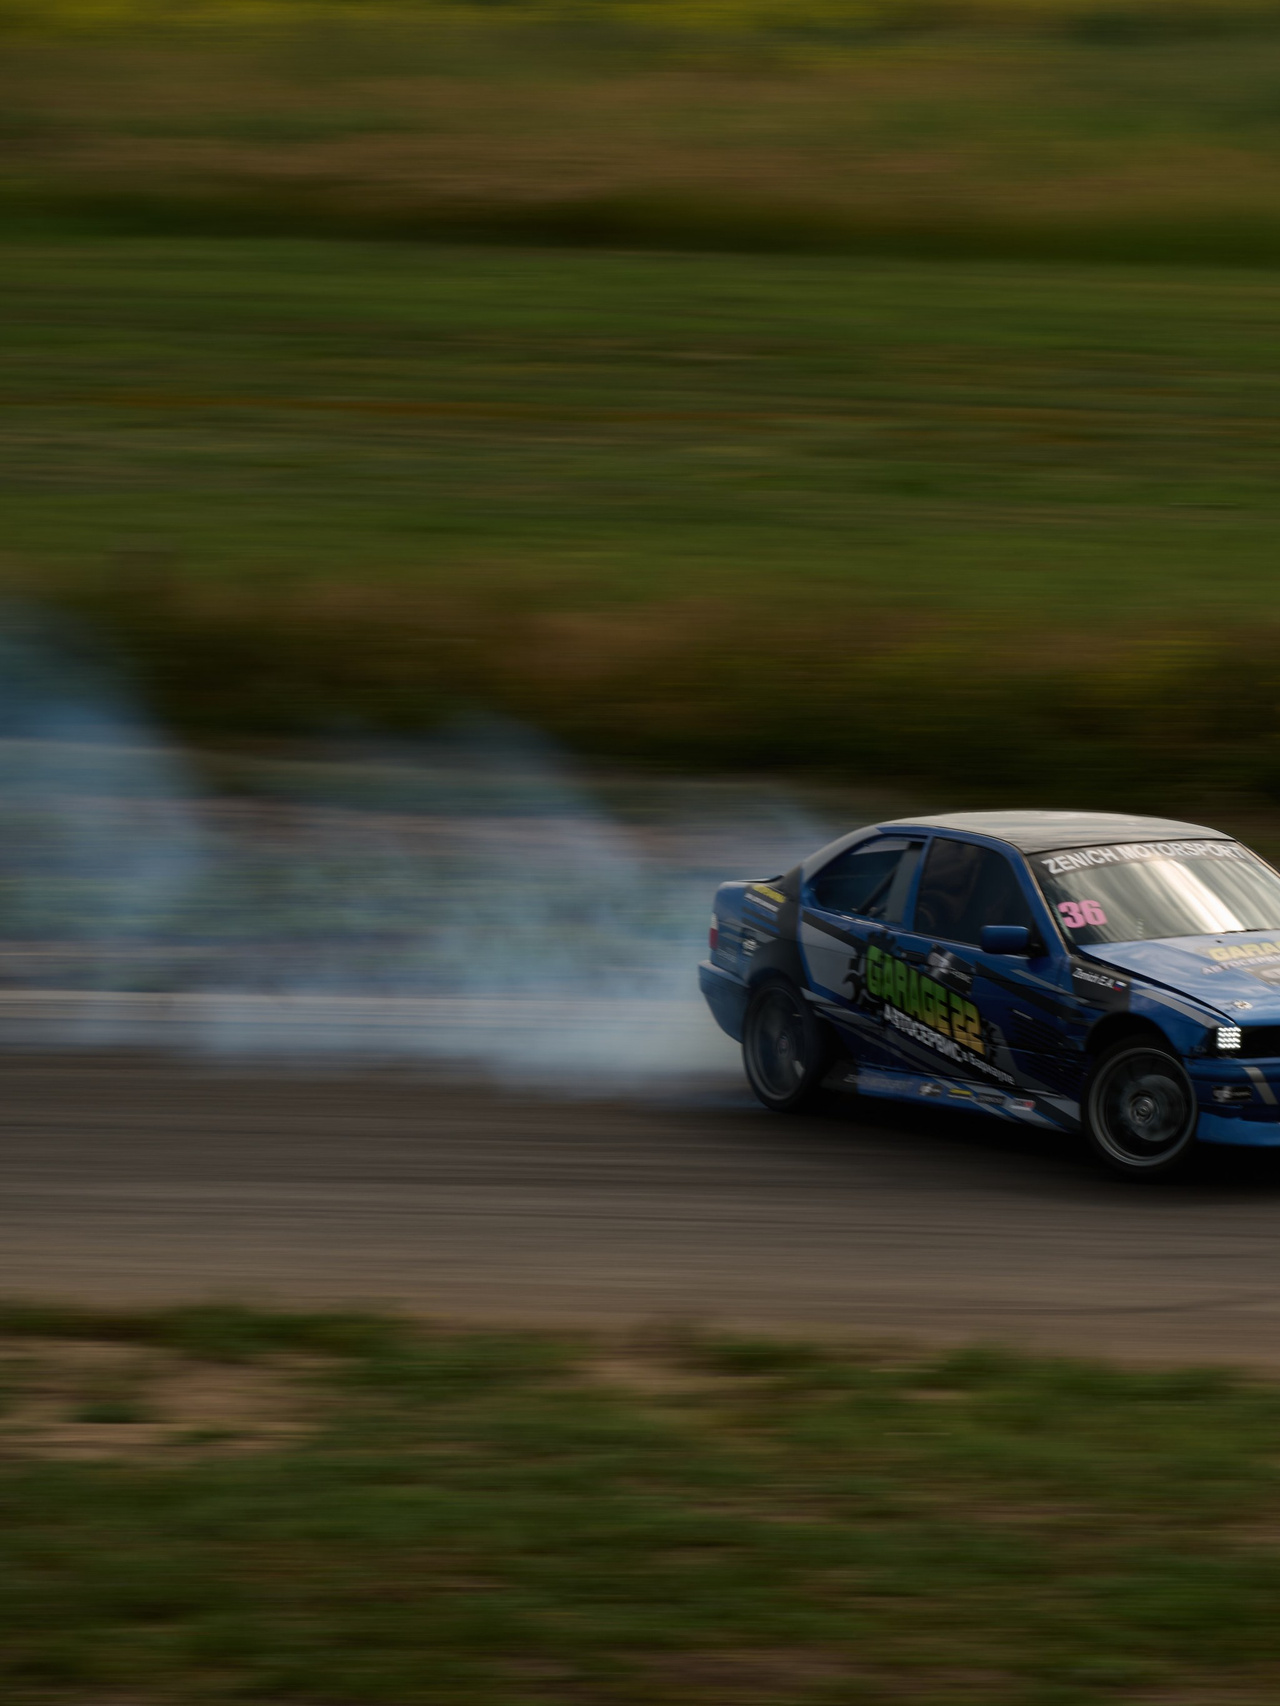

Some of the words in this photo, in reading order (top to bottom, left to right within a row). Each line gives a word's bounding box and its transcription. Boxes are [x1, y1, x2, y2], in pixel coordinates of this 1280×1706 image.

[1041, 848, 1121, 875] ZENICH
[1116, 842, 1248, 862] MOTORSPORT
[1057, 899, 1108, 929] 36
[883, 1003, 964, 1063] АВТОСЕРВИС
